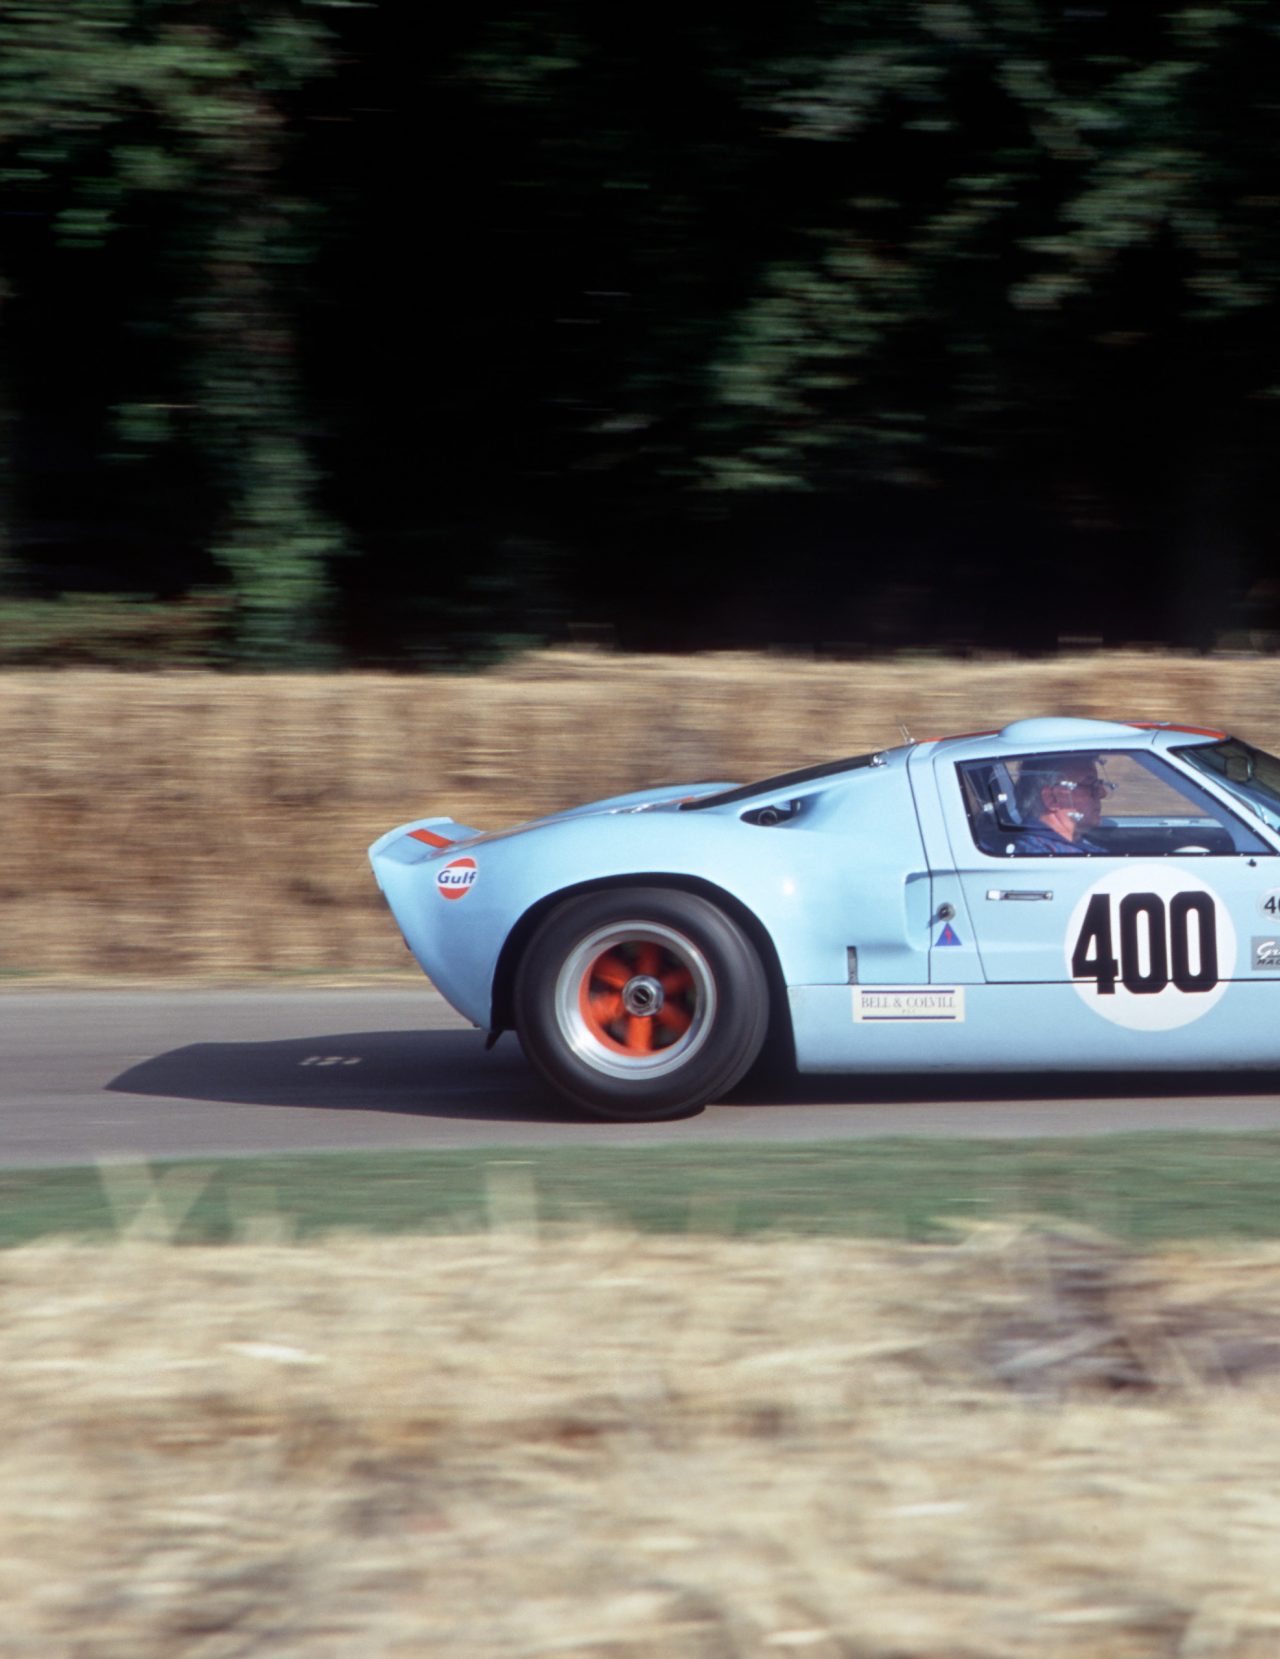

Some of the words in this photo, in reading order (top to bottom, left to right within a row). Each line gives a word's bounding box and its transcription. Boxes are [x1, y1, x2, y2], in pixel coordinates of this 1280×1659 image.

[437, 870, 477, 884] Gulf
[1071, 890, 1219, 995] 400
[861, 997, 890, 1009] BELL
[893, 997, 902, 1009] &
[906, 996, 956, 1009] COLVILL
